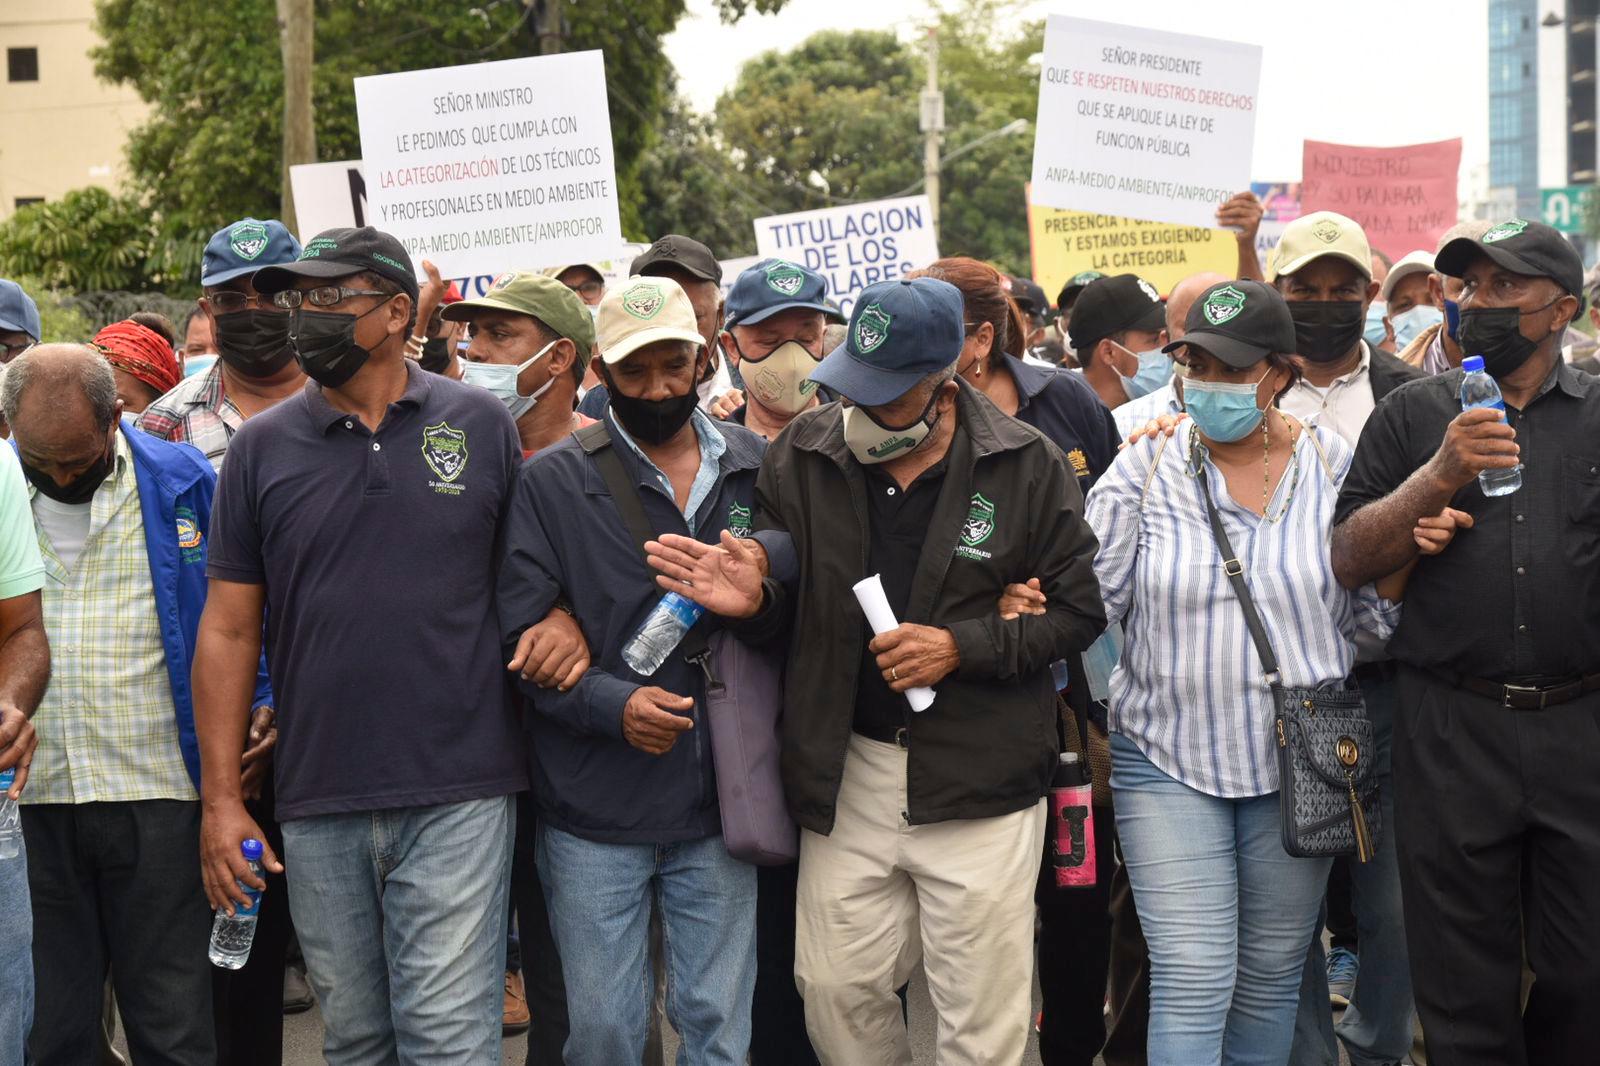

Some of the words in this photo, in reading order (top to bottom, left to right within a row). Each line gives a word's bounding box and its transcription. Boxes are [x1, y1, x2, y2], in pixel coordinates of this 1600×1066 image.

[1101, 46, 1137, 66] SEÑOR
[1140, 54, 1202, 76] PRESIDENTE
[433, 92, 472, 115] SEÑOR
[476, 87, 533, 110] MINISTRO
[1047, 67, 1070, 84] QUE
[1072, 71, 1085, 86] SE
[1088, 73, 1138, 94] RESPETEN
[1141, 82, 1196, 102] NUESTROS
[1199, 89, 1253, 110] DERECHOS
[1077, 100, 1100, 117] QUE
[1103, 103, 1115, 118] SE
[1117, 105, 1161, 126] APLIQUE
[1165, 112, 1177, 128] LA
[1181, 114, 1197, 130] LEY
[1201, 117, 1213, 133] DE
[397, 134, 409, 152] LE
[413, 128, 466, 151] PEDIMOS
[472, 124, 496, 144] QUE
[500, 119, 549, 141] CUMPLA
[552, 116, 577, 135] CON
[1096, 130, 1144, 151] FUNCION
[1147, 135, 1190, 157] PÚBLICA
[381, 170, 395, 189] LA
[397, 155, 498, 186] CATEGORIZACIÓN
[502, 157, 516, 175] DE
[520, 154, 541, 173] LOS
[544, 147, 601, 170] TÉCNICOS
[1045, 167, 1115, 189] ANPA-MEDIO
[381, 205, 390, 222] Y
[392, 194, 484, 222] PROFESIONALES
[487, 192, 502, 211] EN
[505, 187, 545, 209] MEDIO
[548, 180, 608, 204] AMBIENTE
[400, 232, 470, 256] NPA-MEDIO
[474, 216, 603, 249] AMBIENTE/ANPROFOR
[769, 205, 923, 249] TITULACION
[1045, 214, 1117, 234] PRESENCIA
[1064, 237, 1071, 252] Y
[1077, 232, 1137, 250] ESTAMOS
[1142, 228, 1211, 246] EXIGIENDO
[804, 245, 845, 271] DE
[846, 237, 897, 265] LOS
[1093, 253, 1109, 269] LA
[1113, 249, 1187, 267] CATEGORÍA
